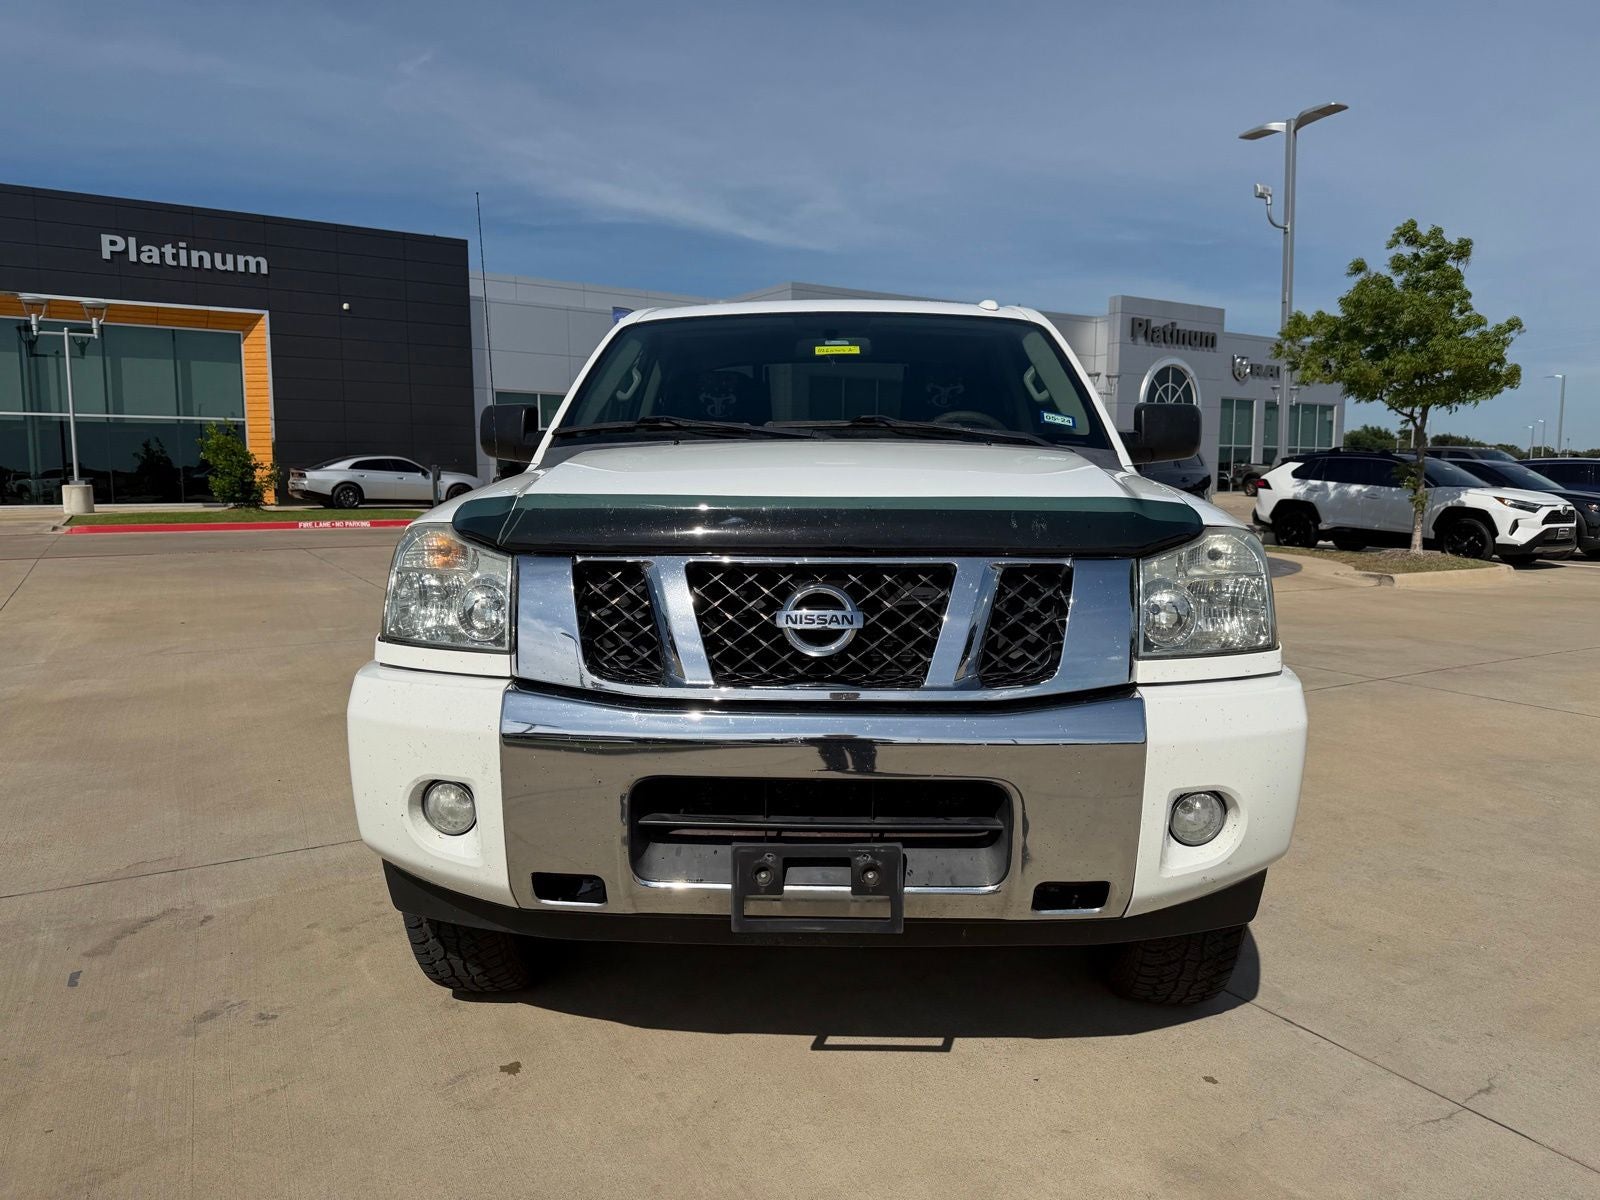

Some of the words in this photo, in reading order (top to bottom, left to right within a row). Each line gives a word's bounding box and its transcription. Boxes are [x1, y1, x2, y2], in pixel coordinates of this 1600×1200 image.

[100, 233, 269, 275] Platinum
[1130, 317, 1218, 349] Platinum
[1045, 414, 1072, 425] 05-24
[298, 521, 313, 529] FIRE
[785, 614, 854, 626] NISSAN
